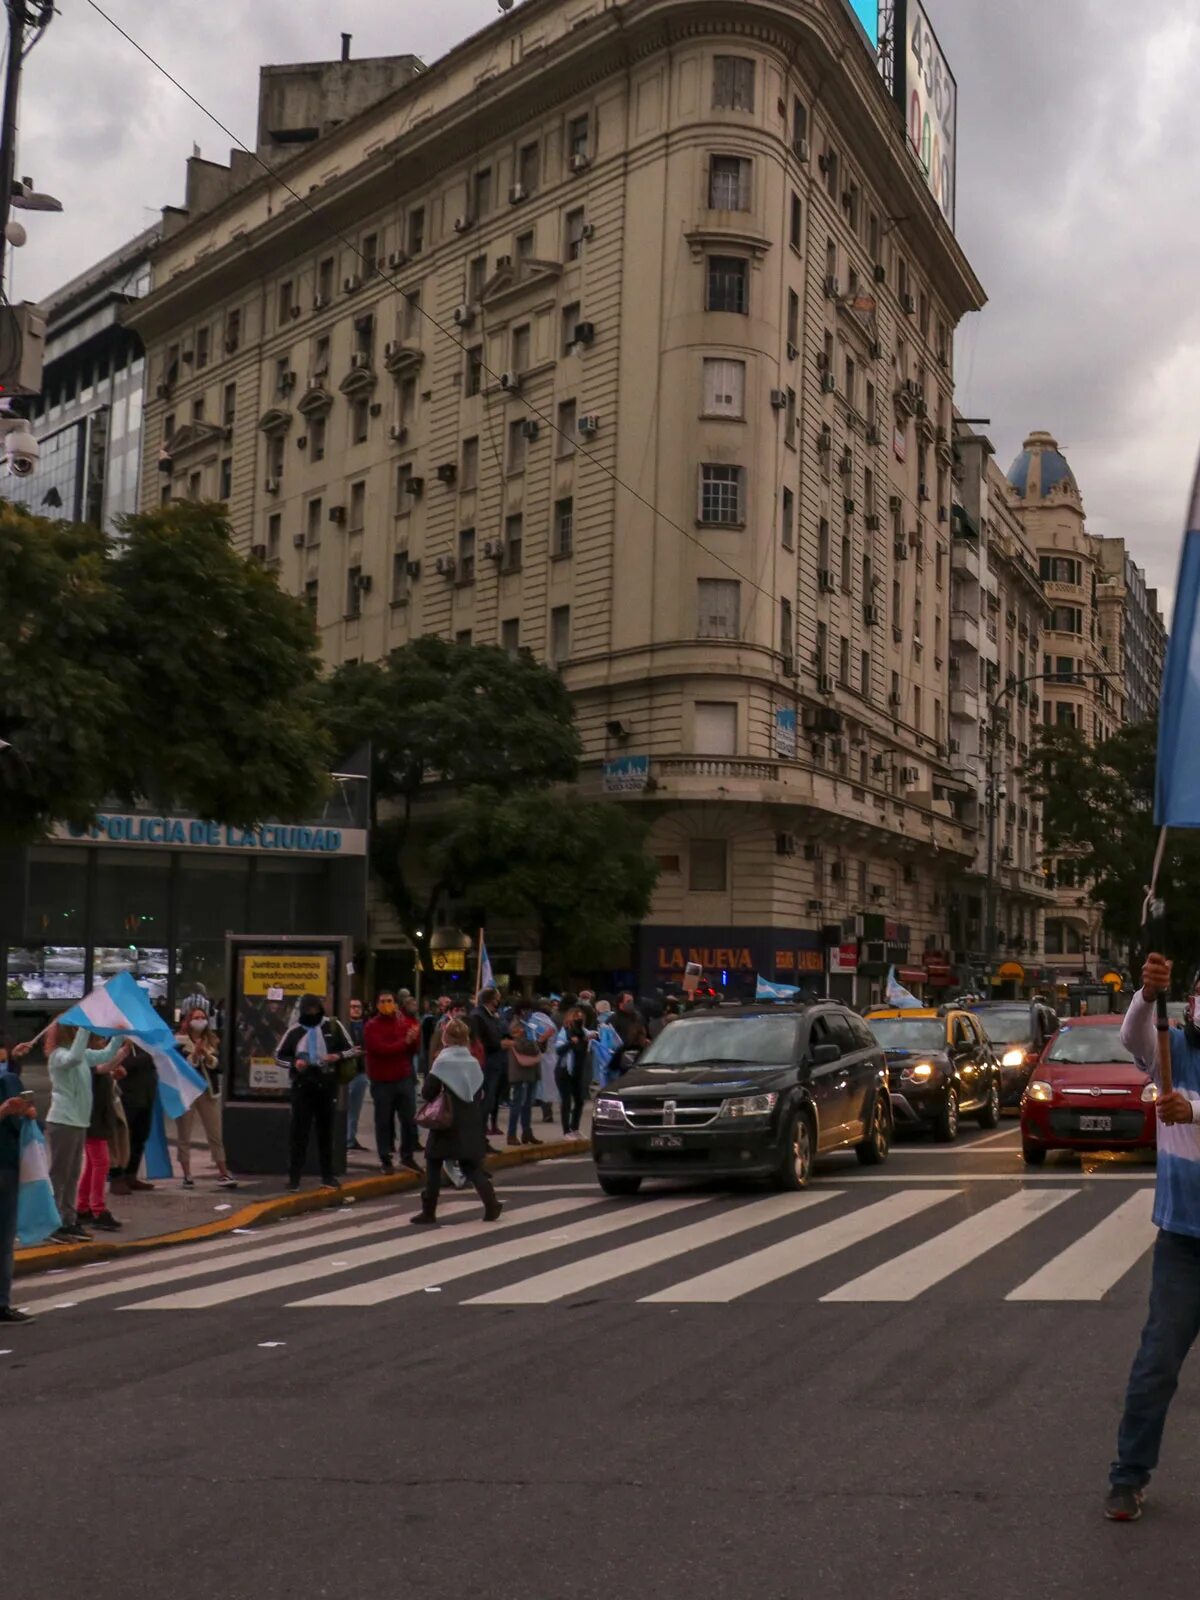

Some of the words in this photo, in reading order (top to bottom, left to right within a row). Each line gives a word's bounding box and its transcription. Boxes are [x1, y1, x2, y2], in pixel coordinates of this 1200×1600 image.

[190, 819, 221, 845] DE
[226, 820, 257, 847] LA
[260, 825, 342, 851] CIUDAD
[251, 961, 281, 969] Juntos
[282, 961, 321, 969] estamos
[658, 947, 685, 968] LA
[688, 947, 753, 969] NUEVA
[252, 971, 319, 979] transformando
